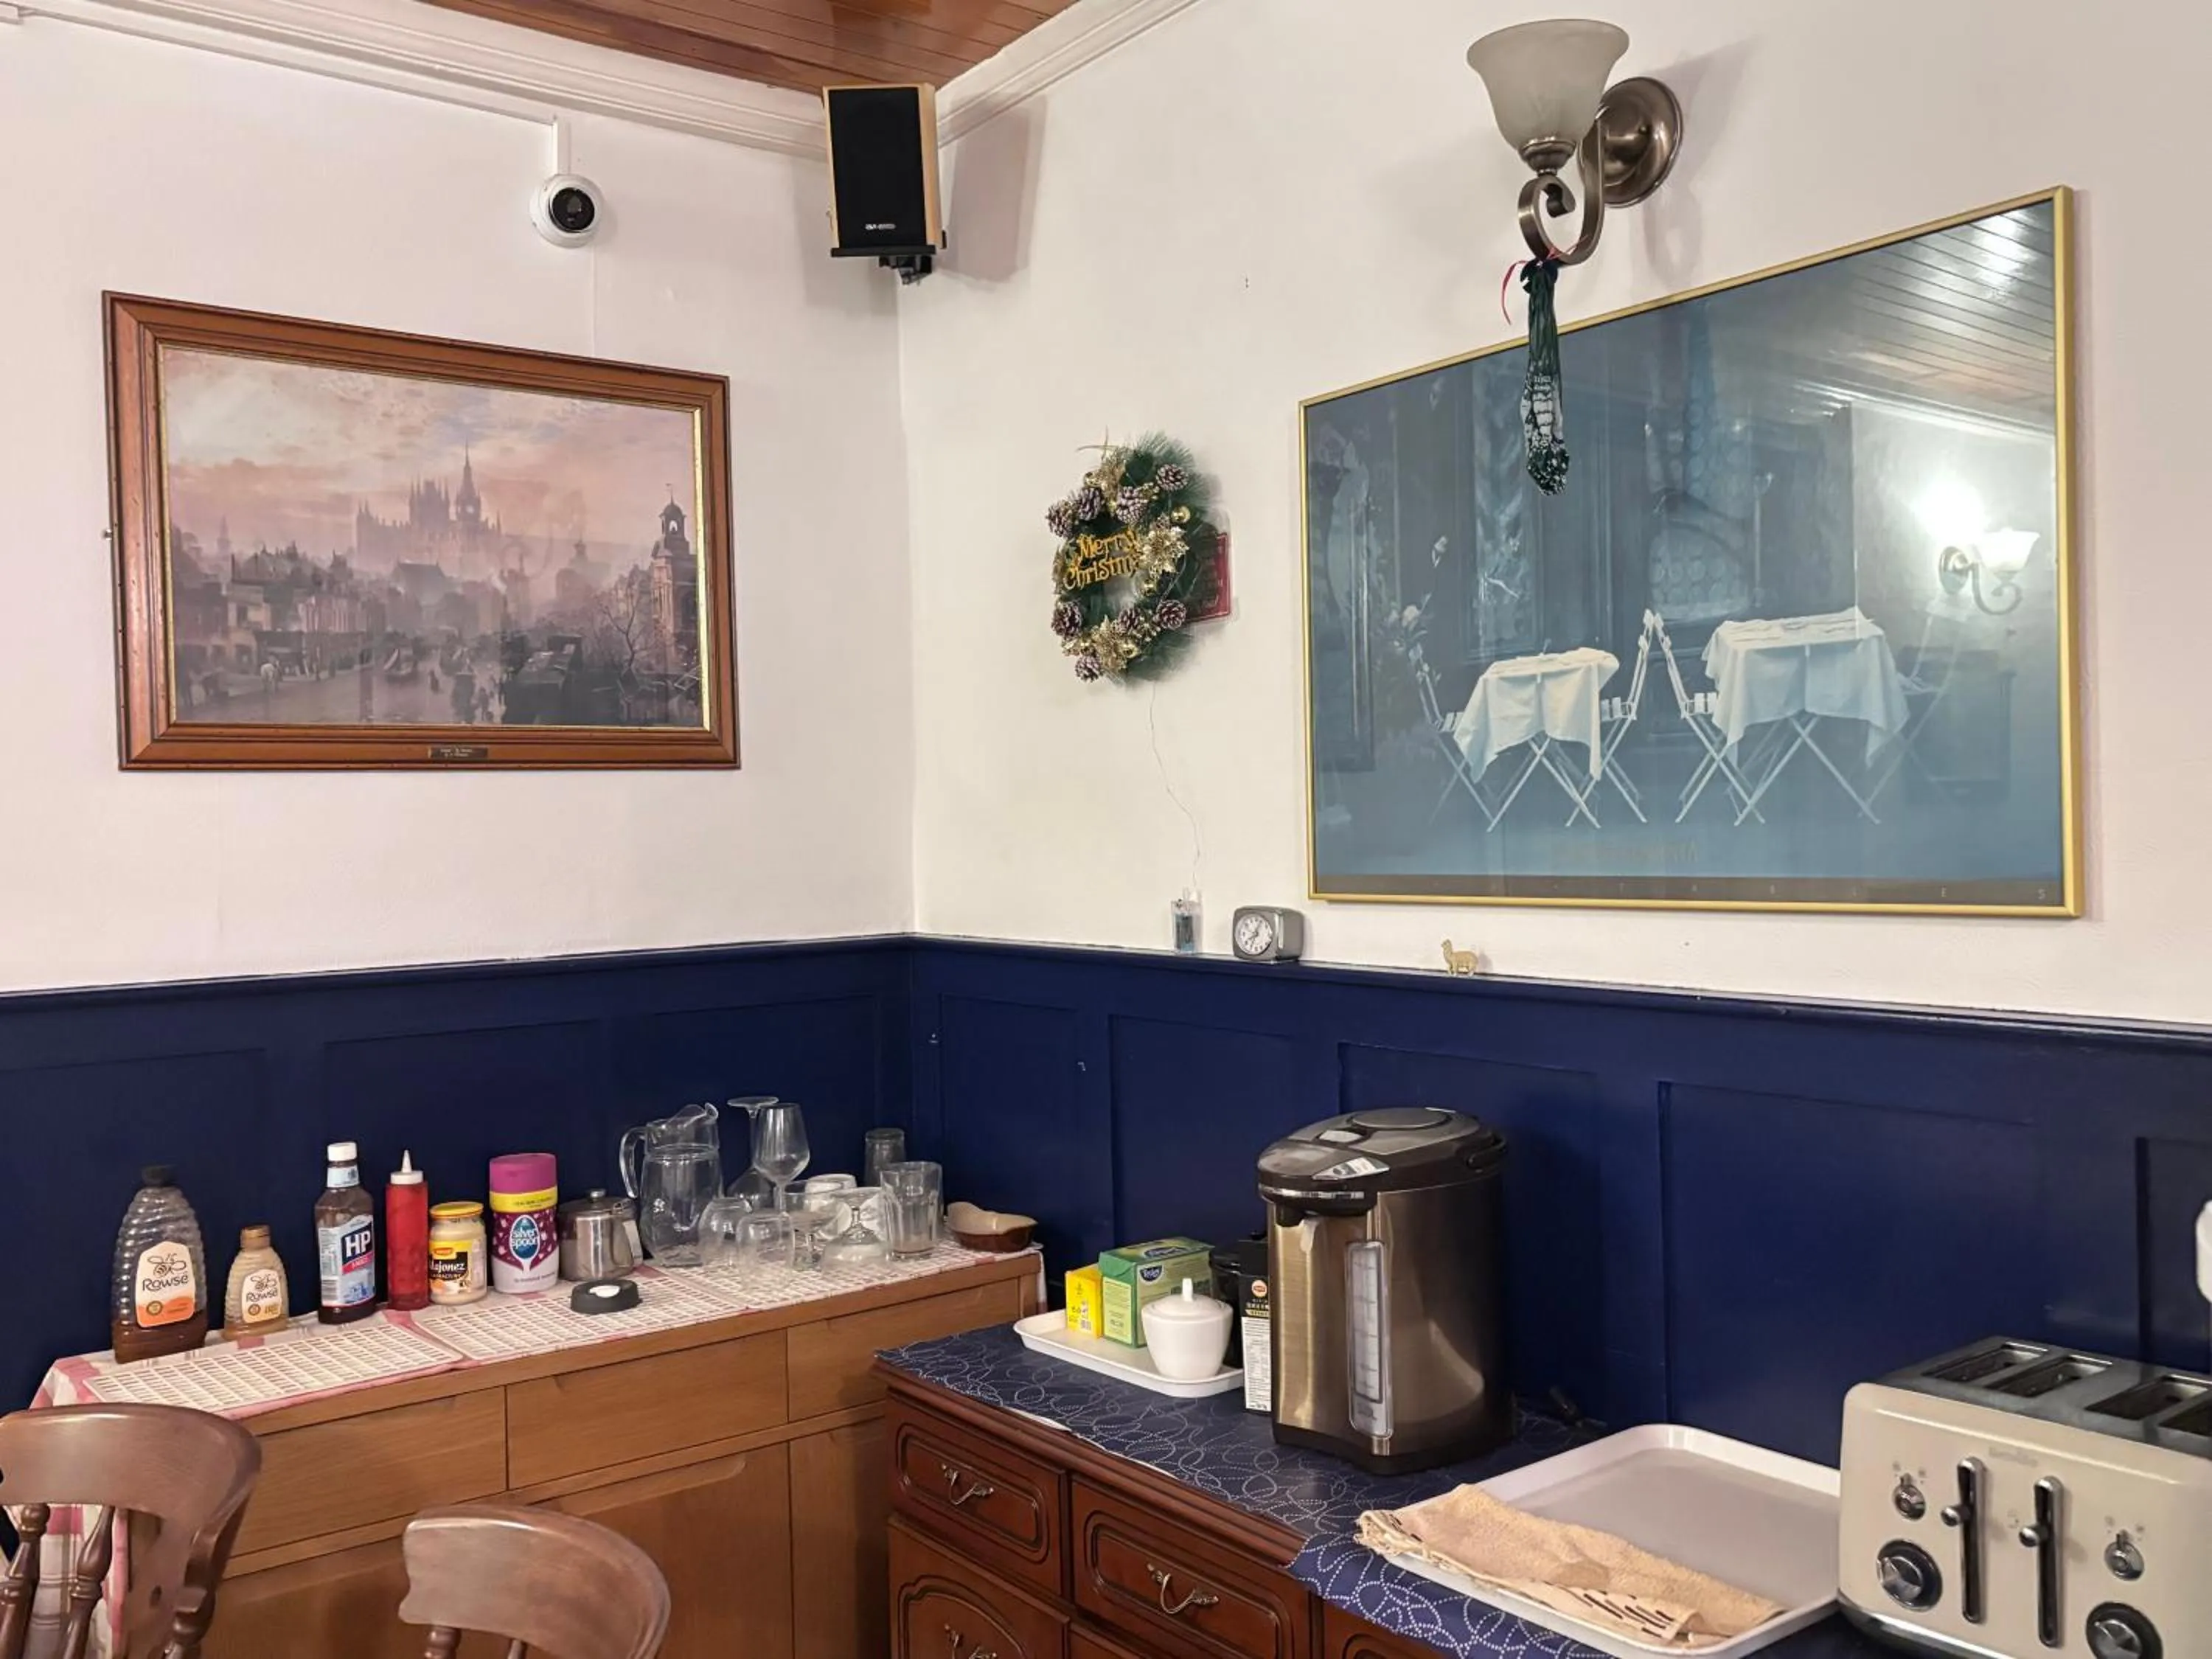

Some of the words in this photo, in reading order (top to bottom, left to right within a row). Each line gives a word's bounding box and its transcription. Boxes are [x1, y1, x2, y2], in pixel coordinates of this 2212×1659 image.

[1062, 554, 1140, 590] Christm
[344, 1230, 371, 1257] HP
[142, 1275, 189, 1291] Rowse
